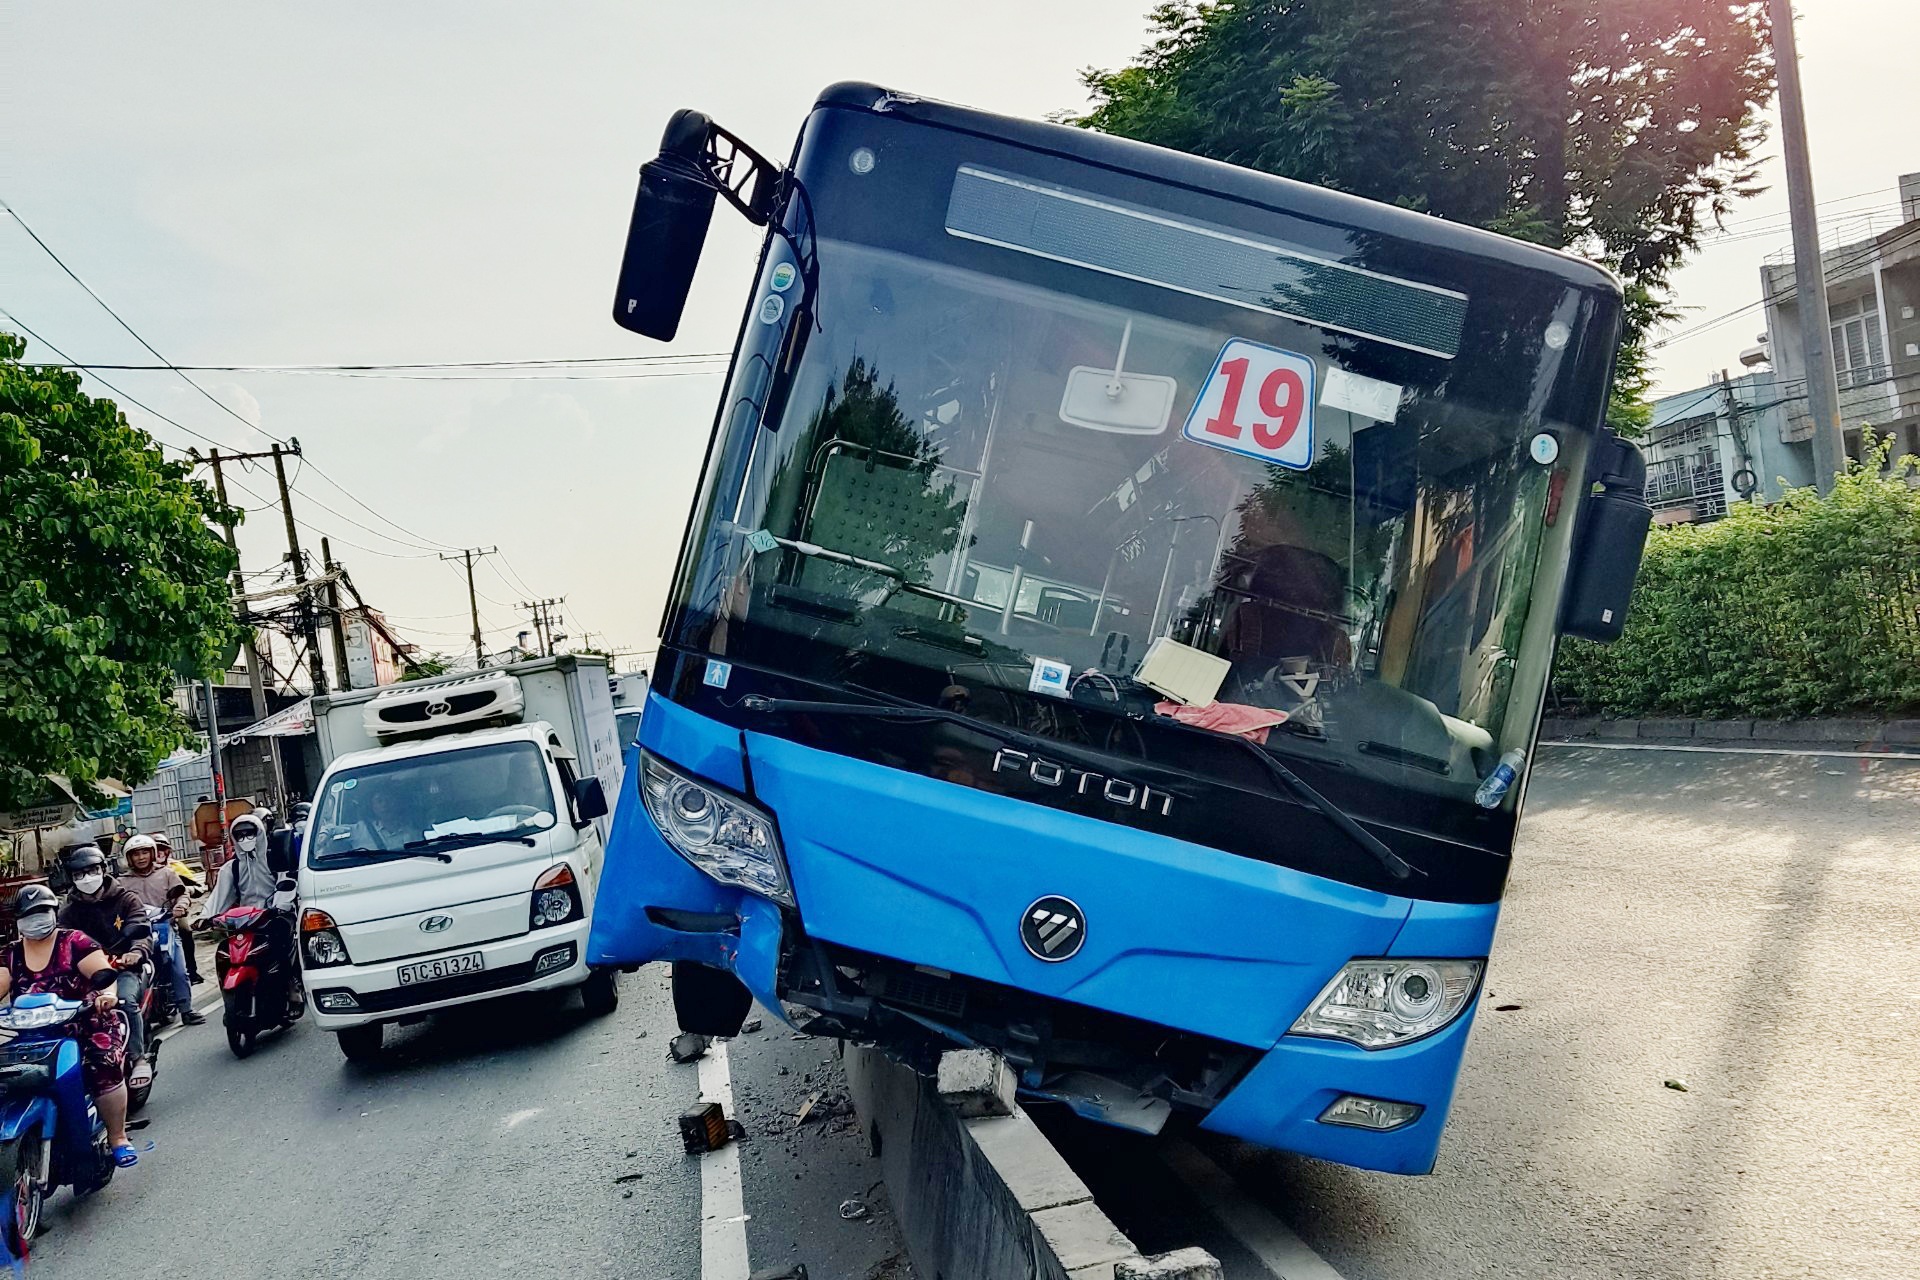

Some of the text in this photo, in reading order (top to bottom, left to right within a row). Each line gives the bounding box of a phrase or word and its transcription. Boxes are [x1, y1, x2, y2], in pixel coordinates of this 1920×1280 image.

[1205, 357, 1305, 450] 19
[752, 534, 774, 549] CNG
[992, 748, 1175, 817] FOTON
[401, 954, 480, 984] 51C-61324
